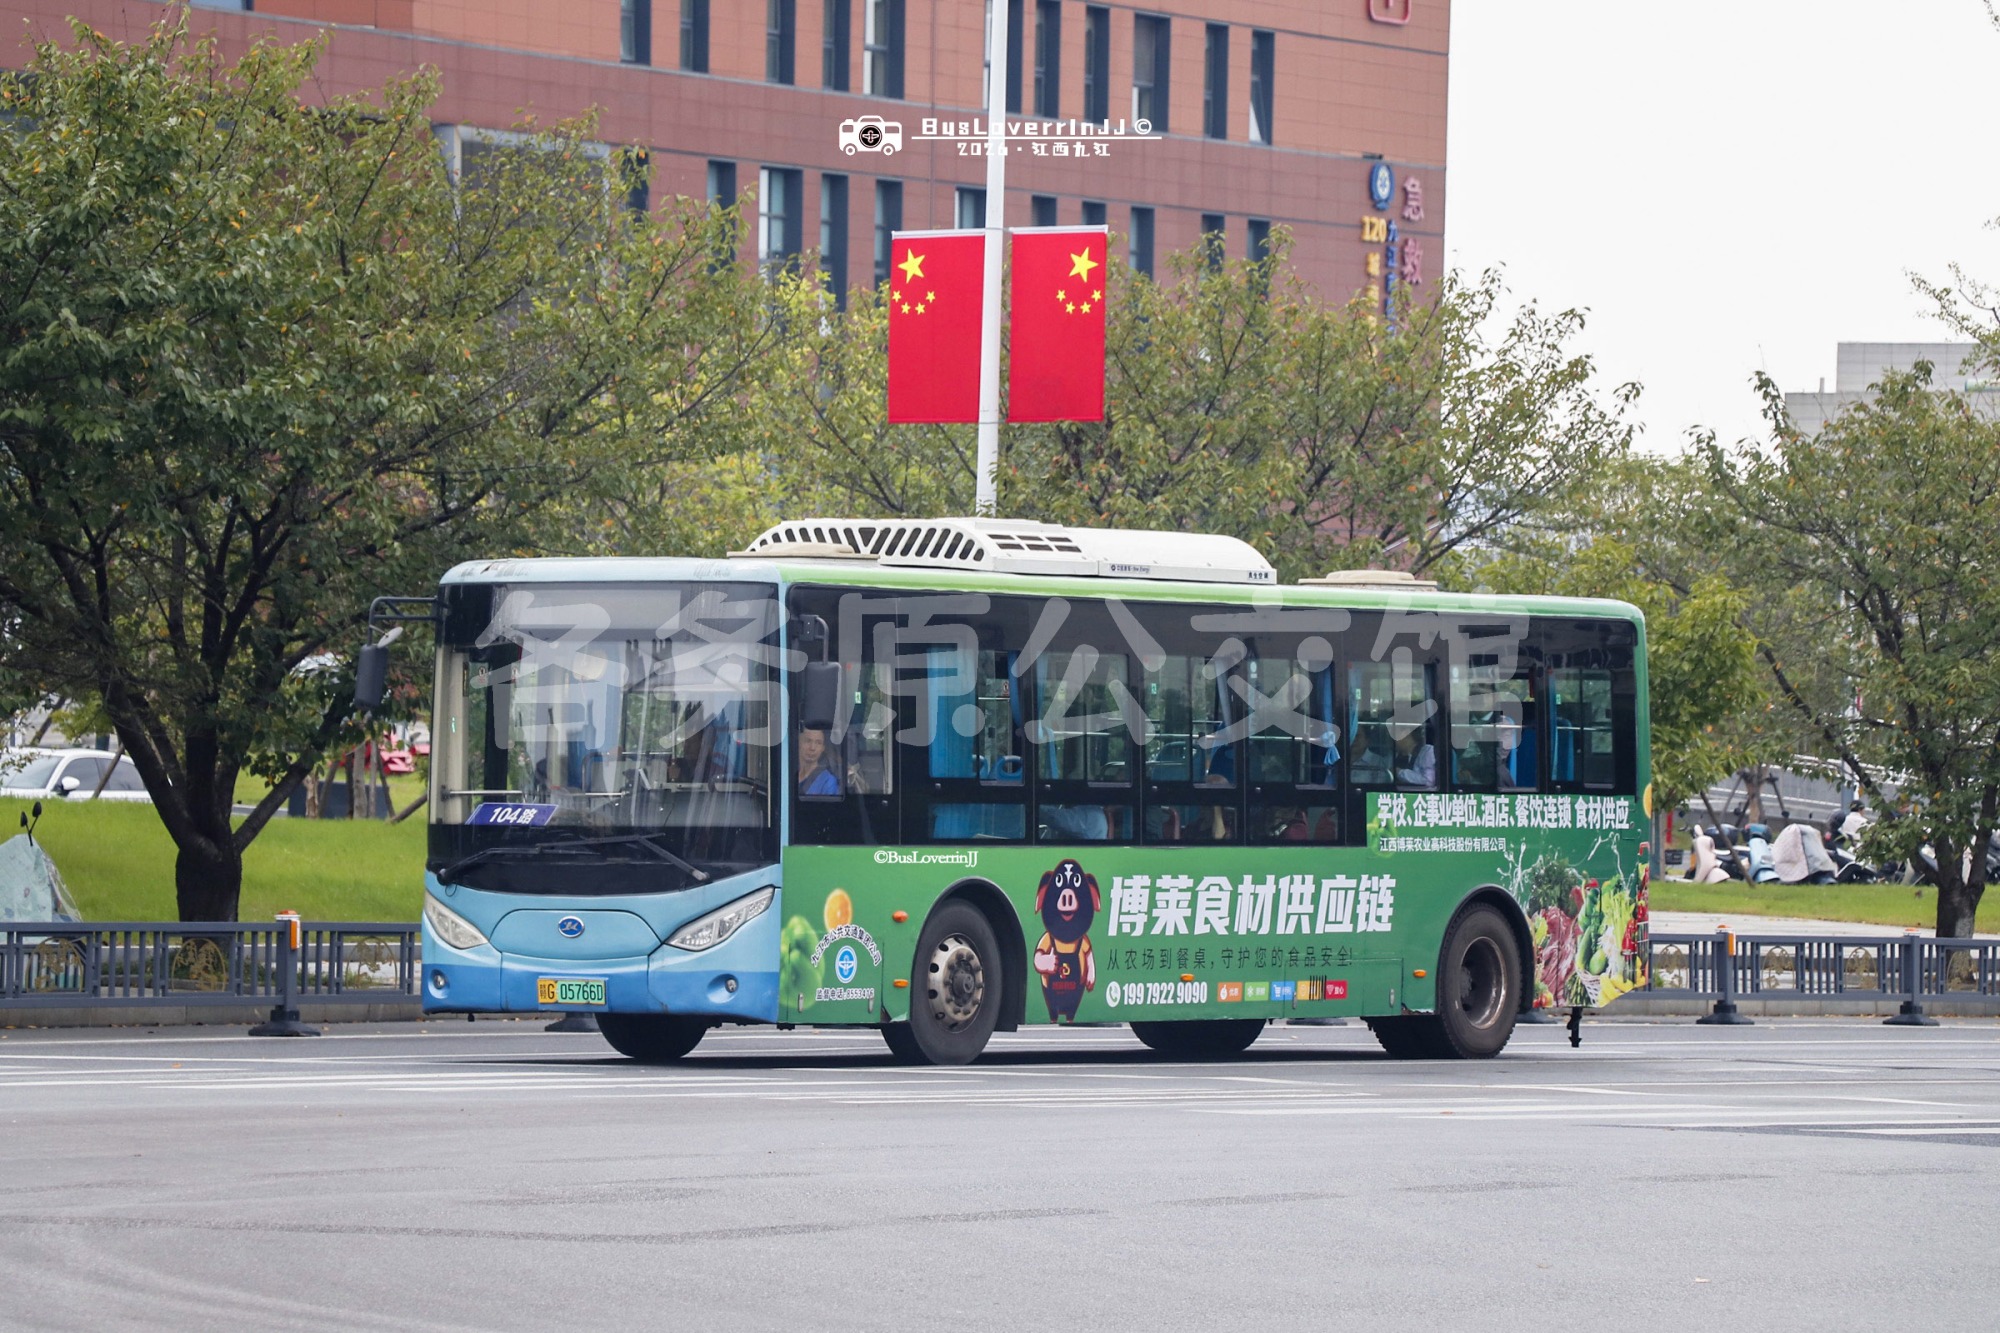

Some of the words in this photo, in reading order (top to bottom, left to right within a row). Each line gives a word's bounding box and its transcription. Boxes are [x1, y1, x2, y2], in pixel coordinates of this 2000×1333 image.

[489, 807, 538, 825] 104路
[1379, 836, 1507, 852] 江西博莱农业高科技股份有限公司
[1107, 874, 1396, 936] 博莱食材供应链
[1123, 982, 1145, 1005] 199
[1147, 981, 1175, 1004] 7922
[1177, 981, 1208, 1004] 9090
